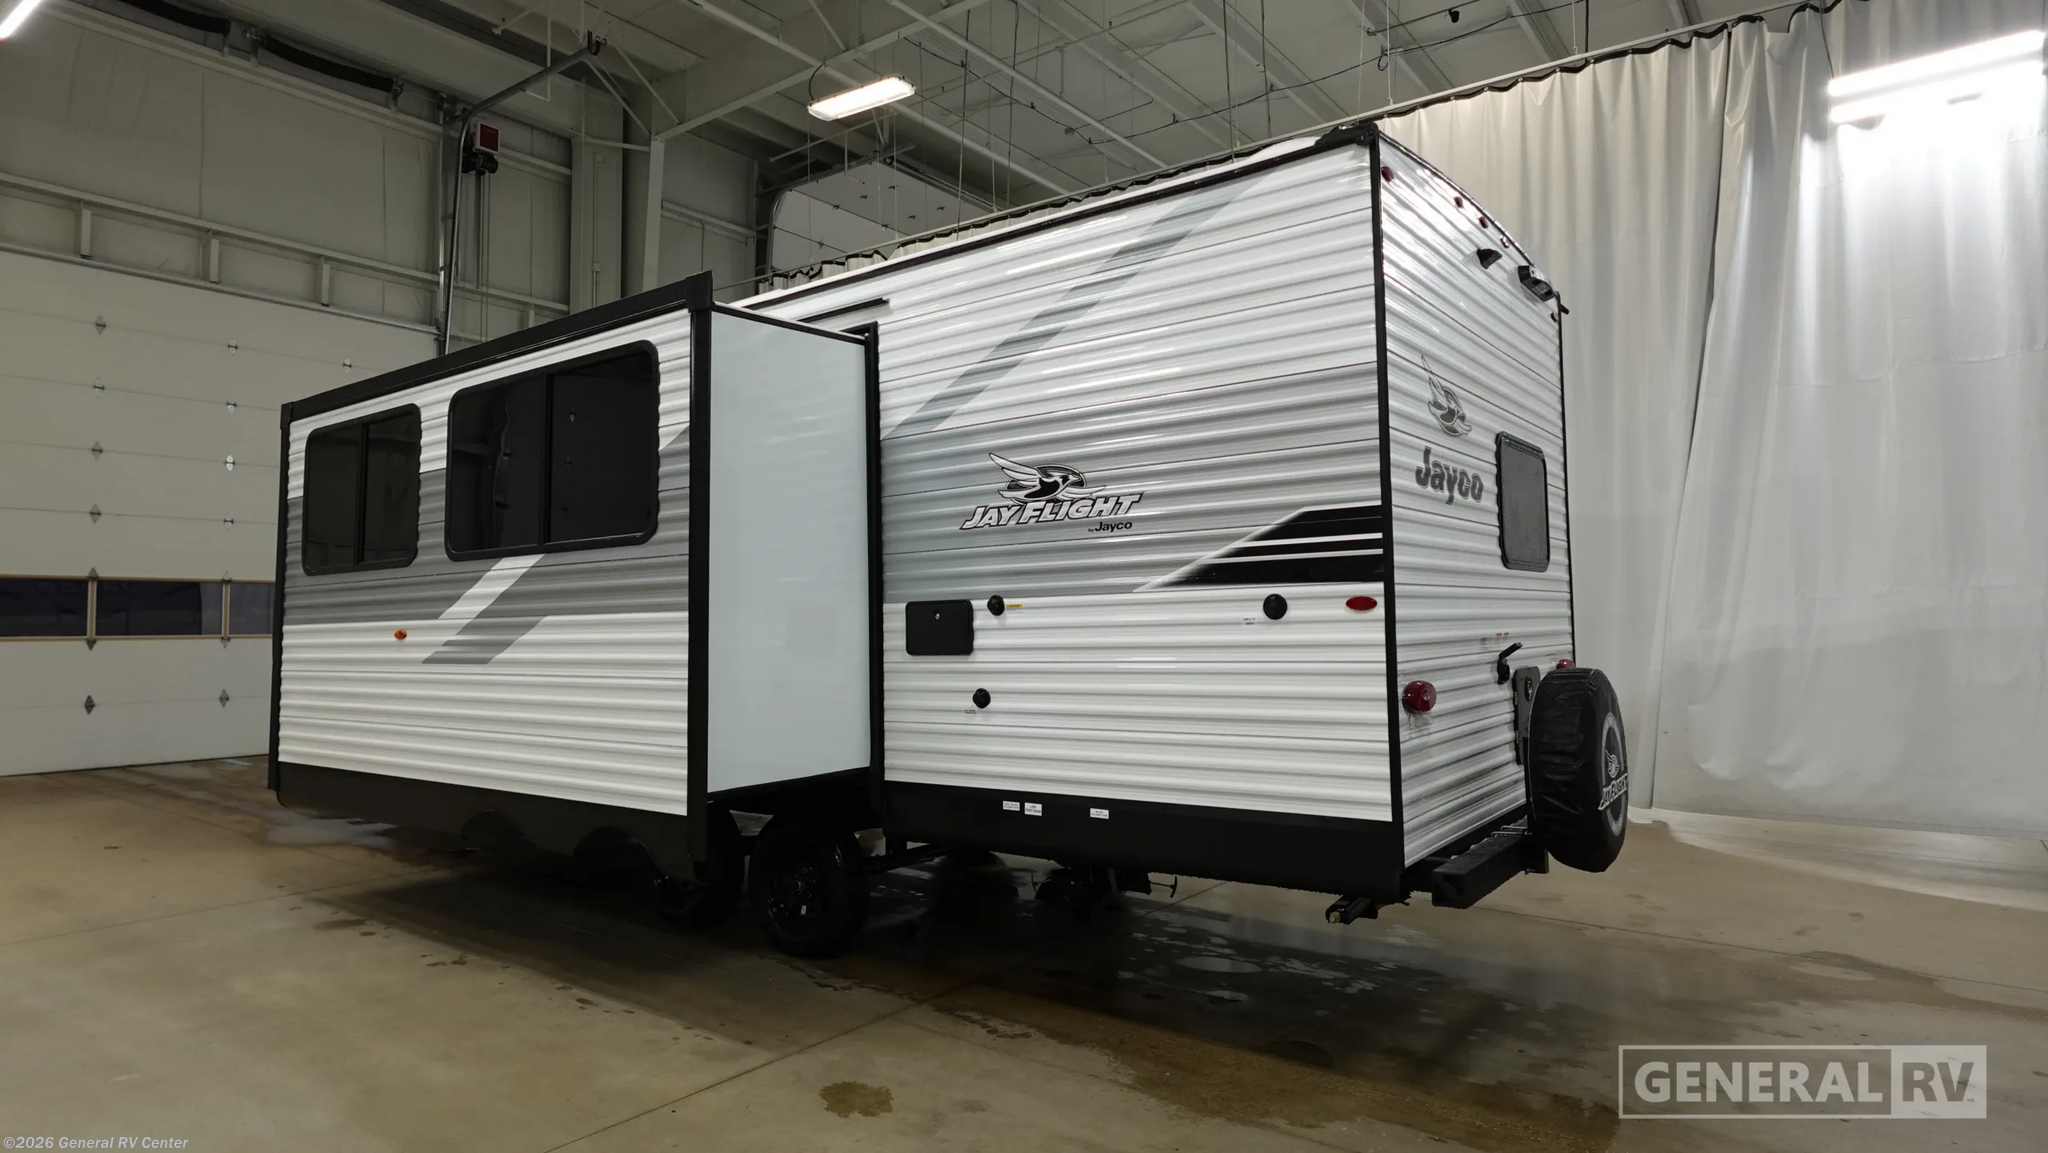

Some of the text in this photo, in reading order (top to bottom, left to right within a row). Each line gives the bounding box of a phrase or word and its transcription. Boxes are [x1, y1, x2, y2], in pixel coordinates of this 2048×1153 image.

[1415, 445, 1484, 505] Jayco
[959, 491, 1145, 530] JAY FLIGHT
[1094, 521, 1133, 533] Jayco
